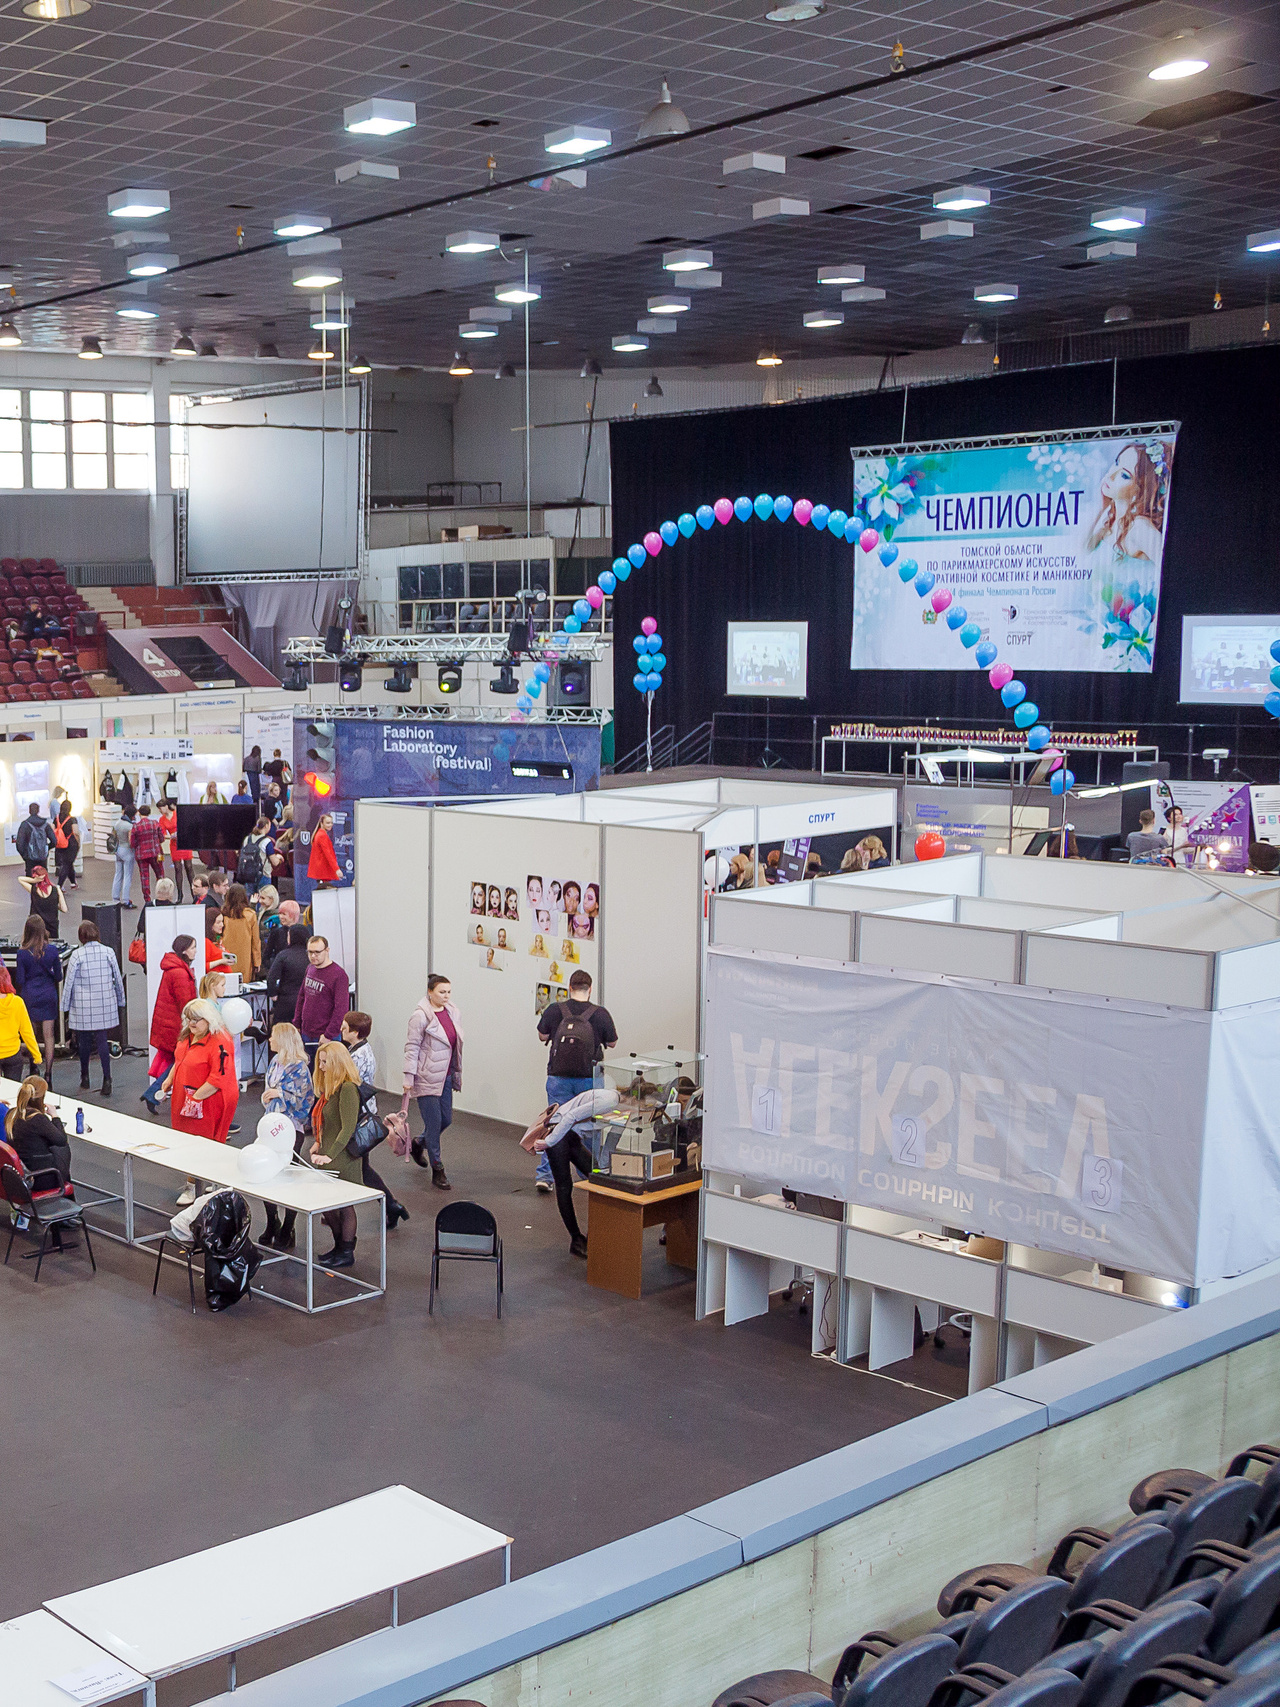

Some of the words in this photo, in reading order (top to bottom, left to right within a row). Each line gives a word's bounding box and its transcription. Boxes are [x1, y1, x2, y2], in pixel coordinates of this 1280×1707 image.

[926, 490, 1084, 531] ЧЕМПИОНАТ
[961, 543, 1001, 557] ТОМСКОЙ
[1004, 544, 1043, 555] ОБЛАСТИ
[926, 561, 938, 571] ПО
[941, 558, 1022, 571] ПАРИКМАХЕРСКОМУ
[1026, 556, 1077, 569] ИСКУССТВУ,
[981, 570, 1030, 583] КОСМЕТИКЕ
[1033, 570, 1039, 581] И
[1041, 569, 1093, 581] МАНИКЮРУ
[957, 587, 985, 599] финала
[986, 586, 1030, 598] Чемпионата
[1031, 585, 1057, 597] России
[1006, 634, 1032, 646] СПУРТ
[143, 648, 166, 667] 4
[152, 669, 181, 678] СЕКТОР
[383, 725, 434, 740] Fashion
[383, 739, 458, 758] Laboratory
[808, 812, 836, 824] СПУРТ
[758, 1089, 775, 1131] 1
[899, 1118, 918, 1164] 2
[1091, 1158, 1113, 1207] 3
